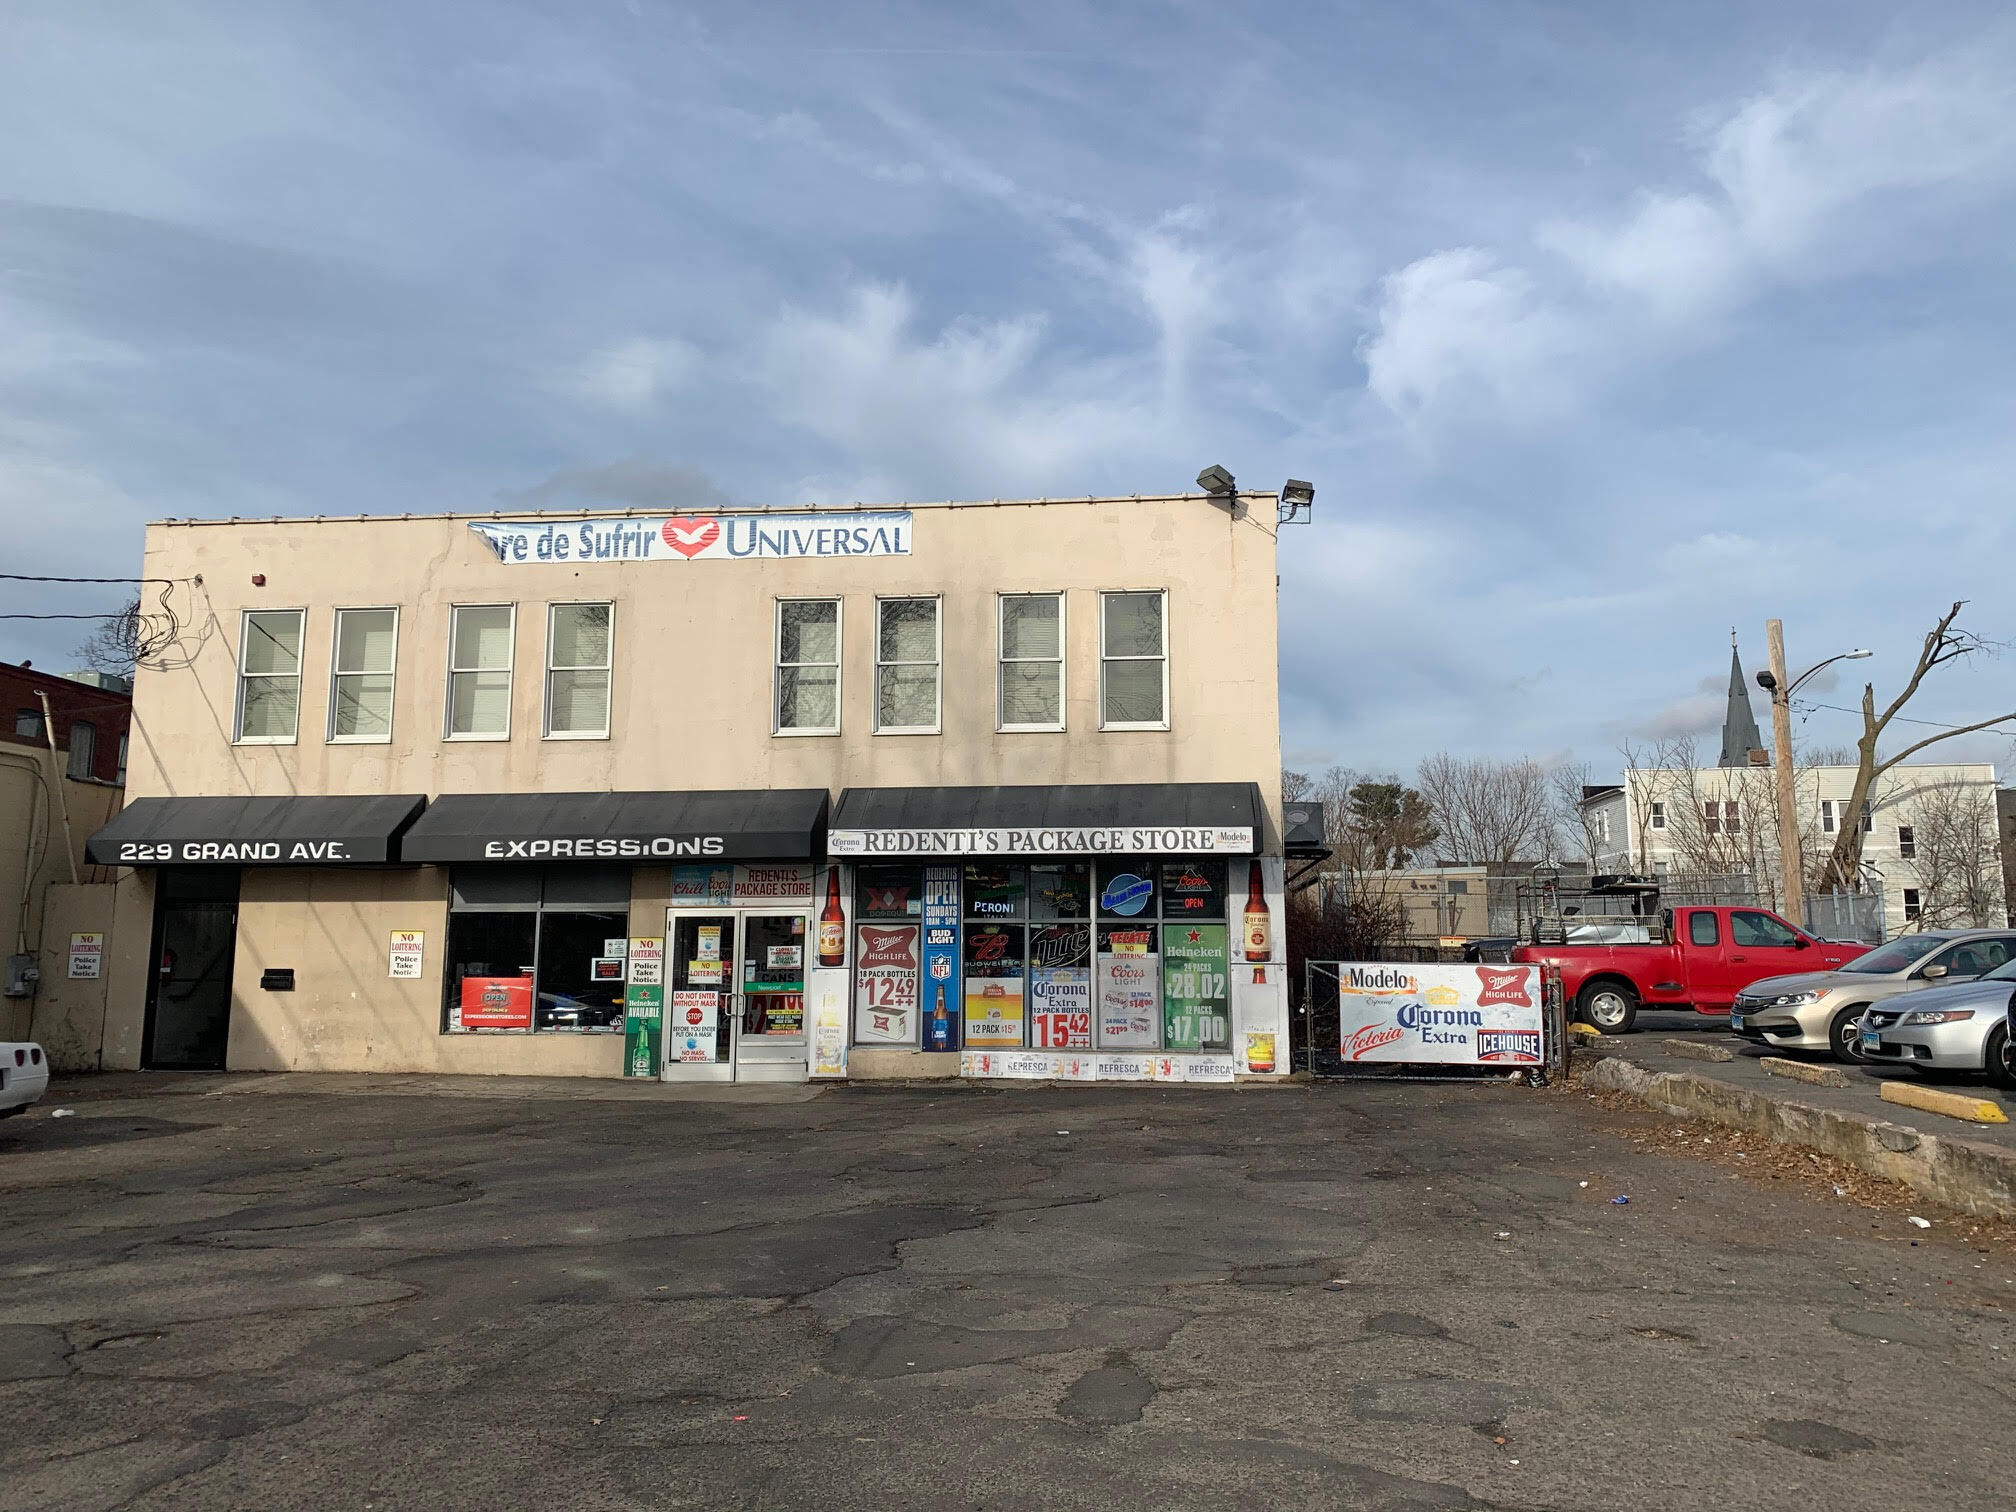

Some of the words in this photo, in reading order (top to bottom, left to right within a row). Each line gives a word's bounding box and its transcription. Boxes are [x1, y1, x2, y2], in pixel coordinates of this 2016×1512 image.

[537, 525, 569, 560] de
[578, 522, 657, 560] Sufrir
[727, 519, 909, 557] UNIVERSAL
[863, 830, 999, 853] REDENTI'S
[1007, 829, 1124, 852] PACKAGE
[1132, 829, 1215, 851] STORE
[1220, 831, 1247, 842] Modelo
[484, 836, 725, 858] EXPRESSIONS
[832, 838, 860, 847] Corona
[119, 843, 172, 860] 229
[182, 842, 280, 860] GRAND
[289, 841, 351, 860] AVE.
[748, 869, 798, 882] REDENTI'S
[926, 867, 957, 880] REDENTIS
[673, 882, 705, 895] Chill
[734, 882, 778, 896] PACKAGE
[780, 882, 811, 896] STORE
[926, 881, 957, 905] OPEN
[974, 901, 1014, 913] PERONI
[1184, 898, 1204, 908] OPEN
[926, 905, 957, 917] SUNDAYS
[1244, 915, 1270, 925] Corona
[400, 933, 414, 942] NO
[931, 929, 951, 937] BUD
[1109, 931, 1151, 944] TECATE
[80, 935, 94, 943] NO
[640, 940, 654, 948] NO
[872, 935, 904, 951] Miller
[927, 936, 954, 944] LIGHT
[391, 943, 422, 951] LOITERING
[1166, 946, 1222, 957] Heineken
[630, 949, 662, 958] LOITERING
[868, 952, 889, 960] HIGH
[890, 952, 907, 960] LIFE
[700, 962, 711, 970] NO
[933, 965, 948, 976] NFL
[1110, 964, 1145, 978] Coors
[1183, 963, 1193, 972] 24
[1193, 963, 1212, 972] PACKS
[761, 973, 795, 983] CANS
[859, 970, 867, 978] 18
[868, 970, 886, 978] PACK
[886, 970, 916, 978] BOTTLES
[1350, 967, 1408, 989] Modelo
[1166, 973, 1225, 999] $28.02
[1488, 974, 1519, 990] Miller
[1033, 981, 1087, 999] Corona
[1485, 990, 1506, 998] HIGH
[1506, 991, 1523, 999] LIFE
[485, 993, 506, 1001] OPEN
[1048, 996, 1077, 1007] Extra
[628, 999, 660, 1007] Heineken
[628, 1007, 660, 1018] AVAILABLE
[1185, 1005, 1193, 1015] 12
[1193, 1005, 1213, 1015] PACKS
[687, 1012, 702, 1020] STOP
[1396, 1003, 1483, 1031] Corona
[972, 1024, 981, 1034] 12
[981, 1024, 1000, 1034] PACK
[1167, 1015, 1225, 1042] $17.00
[1341, 1020, 1405, 1060] Victoria
[1421, 1027, 1468, 1044] Extra
[1479, 1034, 1539, 1056] ICEHOUSE
